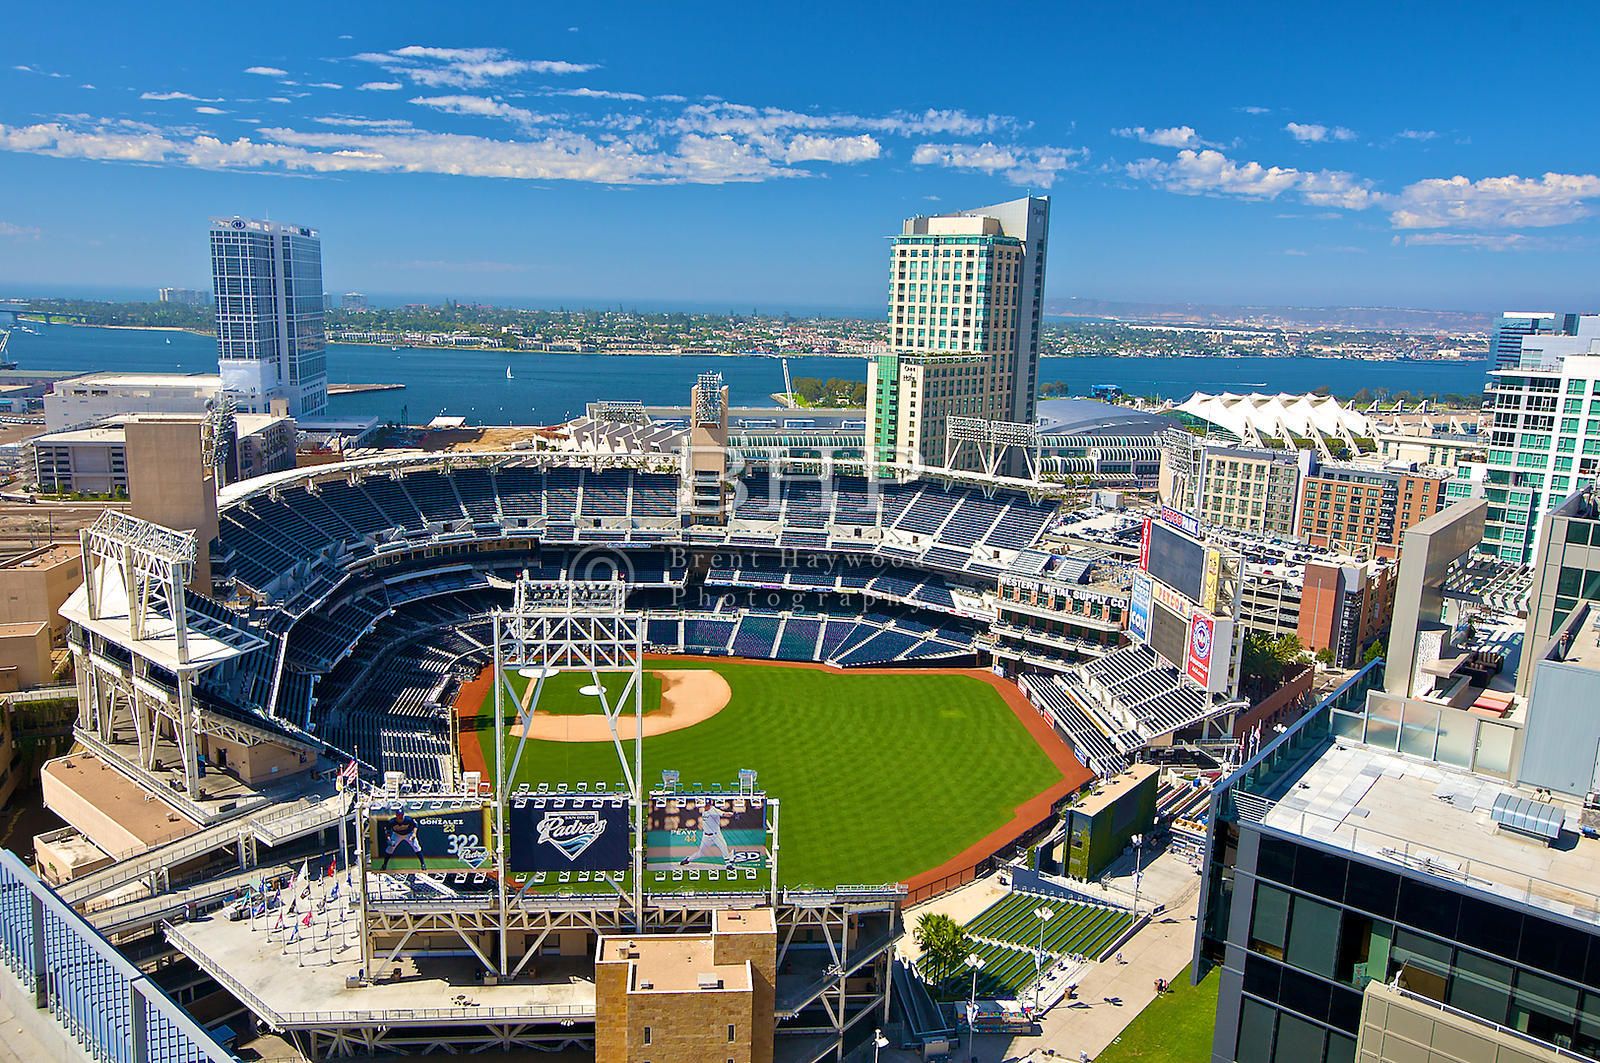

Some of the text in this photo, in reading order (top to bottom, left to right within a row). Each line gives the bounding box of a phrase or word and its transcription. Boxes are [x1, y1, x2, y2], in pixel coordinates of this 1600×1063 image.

[1000, 577, 1040, 592] WESTERN
[1042, 584, 1072, 598] METAL
[1073, 590, 1109, 605] SUPPLY
[443, 823, 456, 833] 23
[537, 816, 608, 844] Padres
